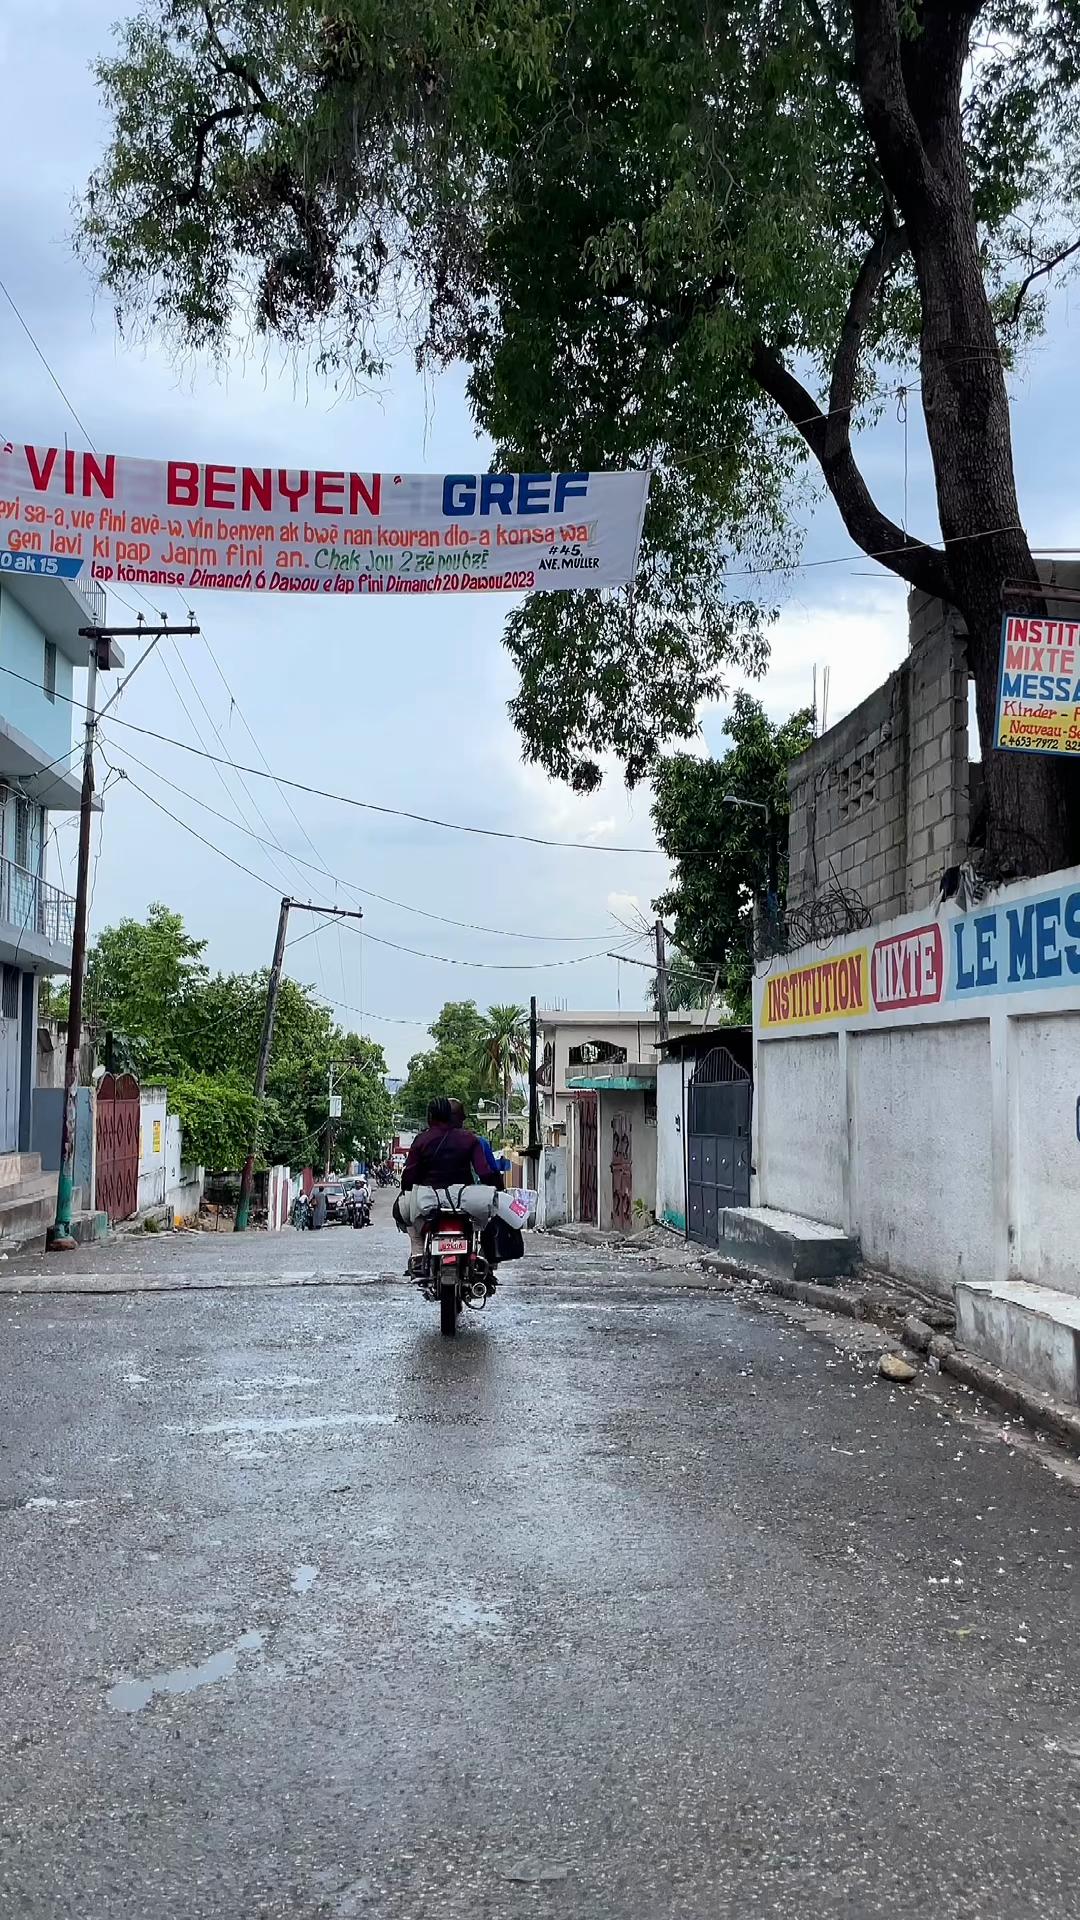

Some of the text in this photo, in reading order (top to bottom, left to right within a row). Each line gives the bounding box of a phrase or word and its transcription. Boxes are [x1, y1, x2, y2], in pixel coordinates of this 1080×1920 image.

[442, 472, 589, 516] GREF
[218, 518, 275, 542] benyen
[280, 521, 299, 542] ak
[344, 527, 372, 546] nan
[378, 524, 439, 547] kouran
[496, 523, 555, 546] konsa
[50, 529, 82, 555] lavi
[93, 534, 110, 558] ki
[116, 541, 151, 565] pap
[226, 544, 262, 567] fini
[14, 555, 36, 572] ak
[40, 557, 59, 574] 15
[189, 568, 252, 589] Dimanch
[255, 570, 266, 589] 6
[269, 571, 320, 592] Dawou
[386, 574, 442, 592] Dimanch
[442, 573, 459, 591] 20
[461, 572, 503, 591] Dawou
[504, 570, 535, 589] 2023
[1007, 618, 1080, 647] INSTIT
[1005, 645, 1075, 675] MIXTE
[767, 954, 863, 1022] INSTITUTION
[874, 930, 937, 1004] MIXTE
[954, 914, 998, 990] LE
